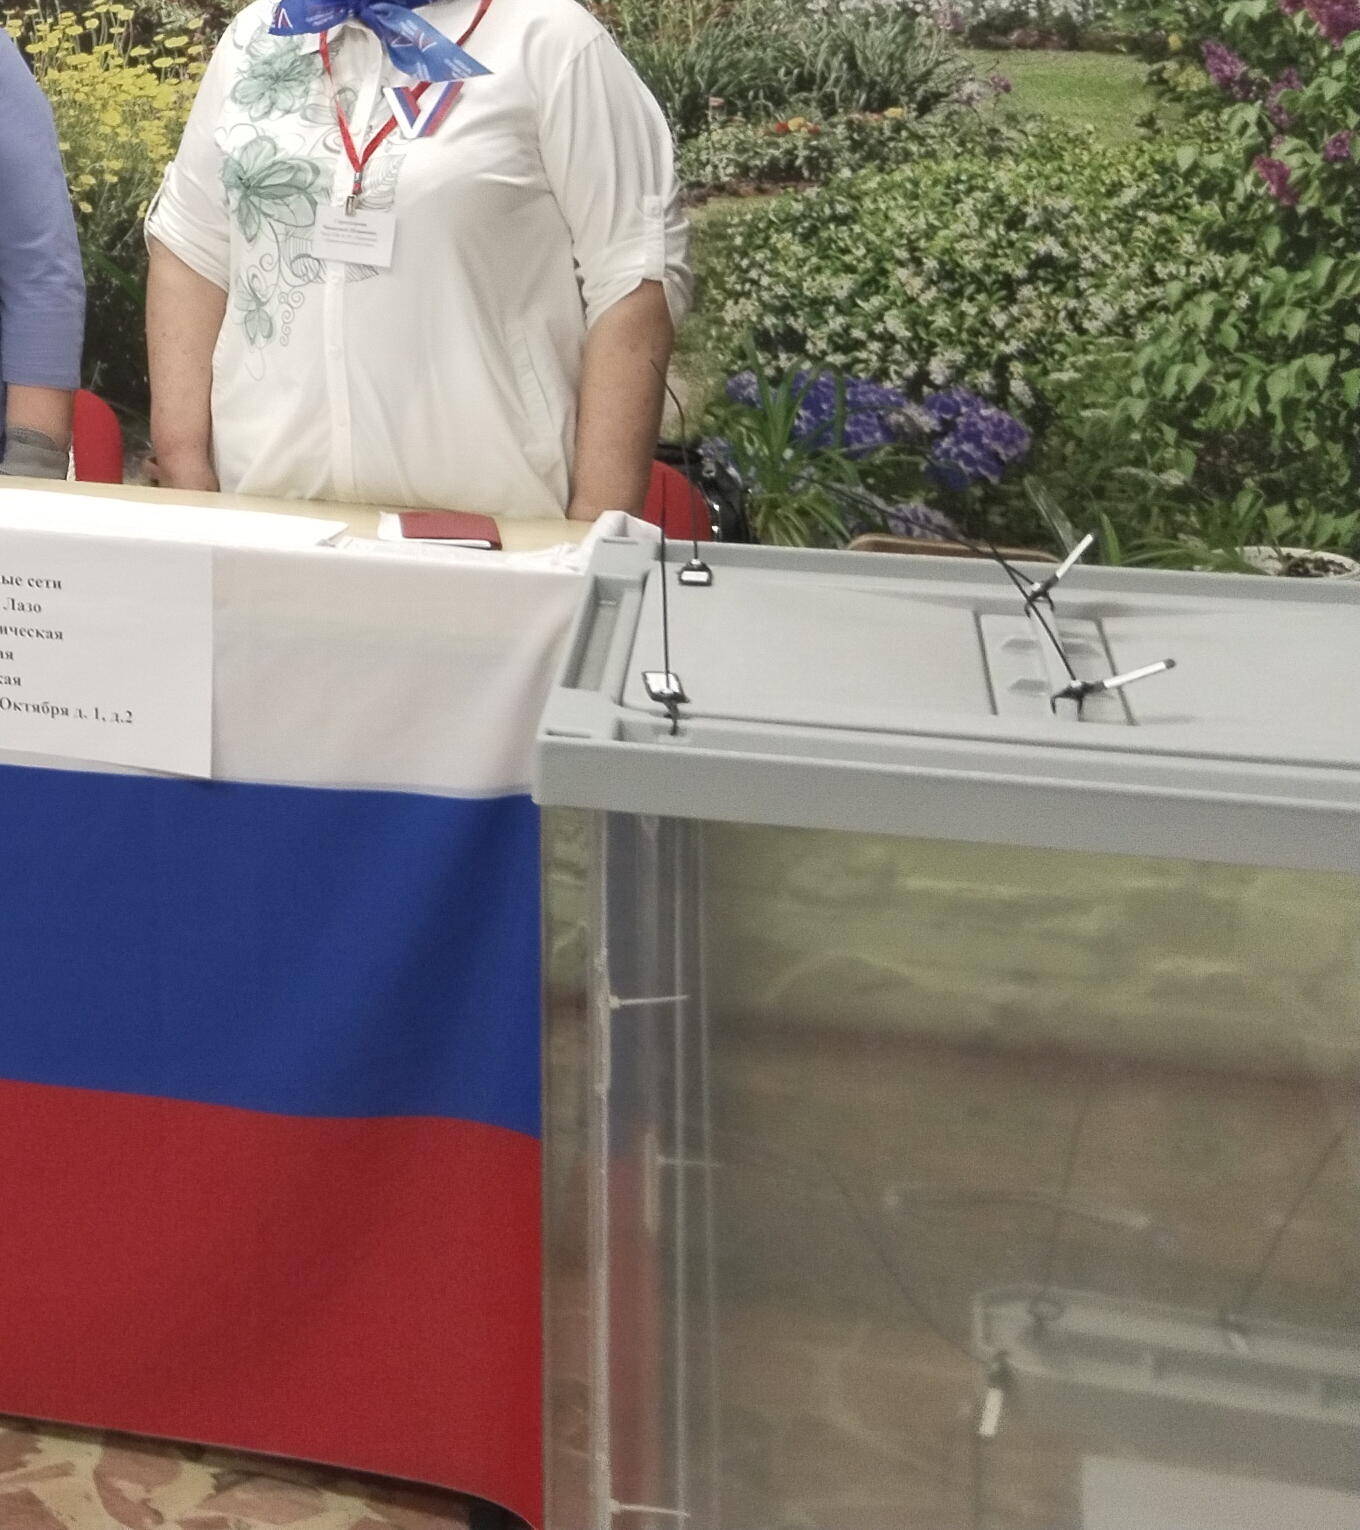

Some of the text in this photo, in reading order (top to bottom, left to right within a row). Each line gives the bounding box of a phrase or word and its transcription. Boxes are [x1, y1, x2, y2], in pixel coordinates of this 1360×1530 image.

[27, 577, 62, 590] сети
[3, 598, 42, 613] Лазо
[0, 696, 69, 719] Октября
[111, 711, 133, 725] д.2
